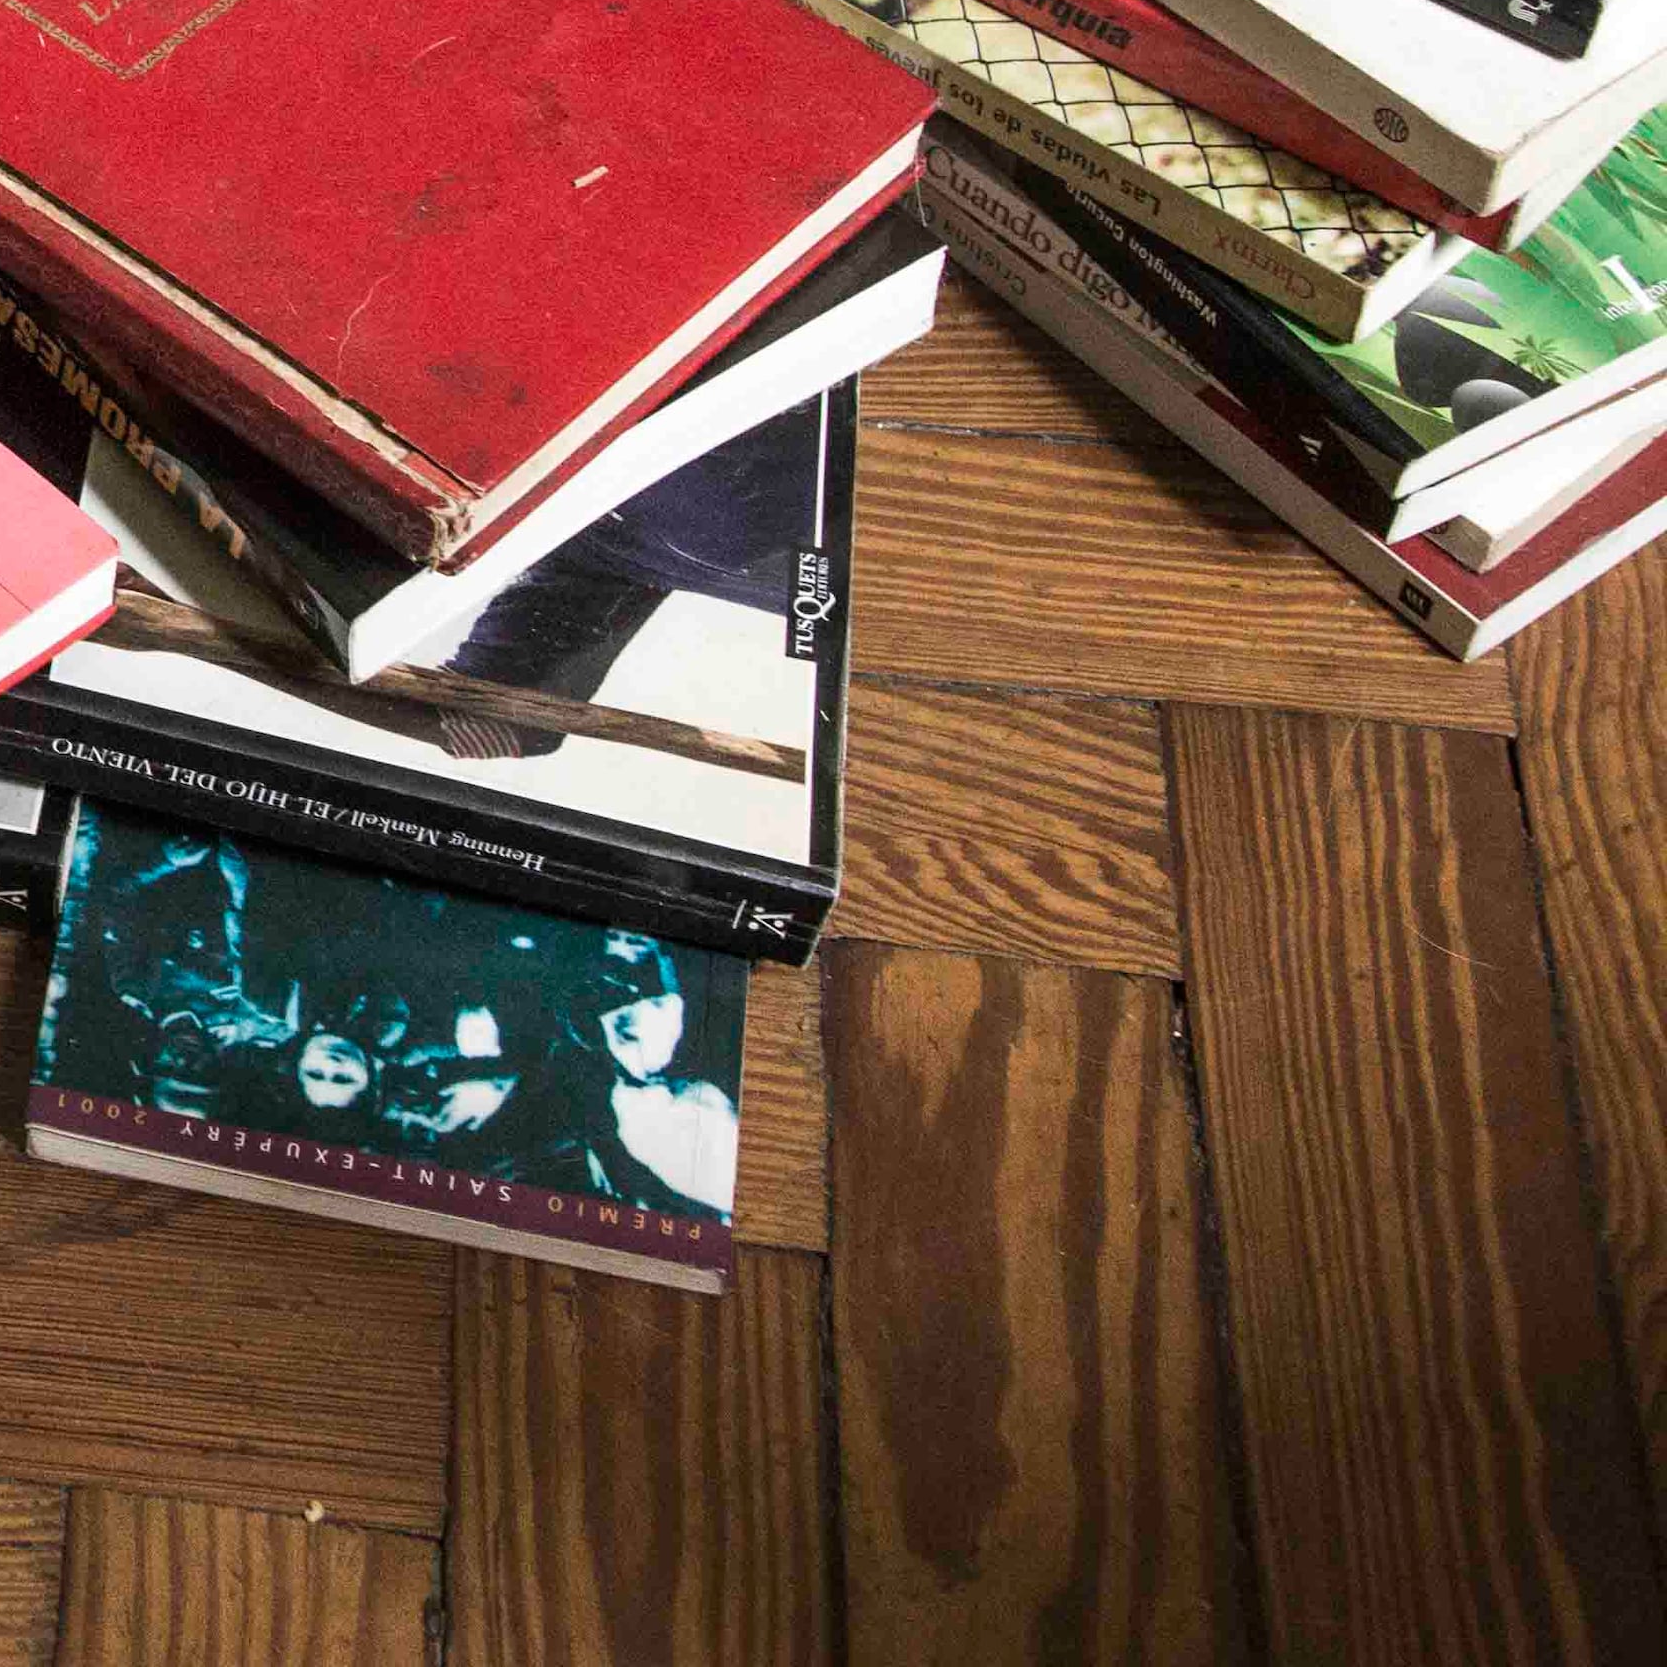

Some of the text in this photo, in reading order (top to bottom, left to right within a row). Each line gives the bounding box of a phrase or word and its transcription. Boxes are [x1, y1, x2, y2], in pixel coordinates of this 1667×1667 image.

[948, 81, 986, 110] los
[993, 106, 1030, 135] de
[1030, 129, 1110, 181] viudas
[925, 144, 1131, 311] Cuando digo
[1120, 178, 1163, 217] Las
[1127, 235, 1219, 329] Washington
[197, 492, 249, 560] LA
[793, 551, 835, 656] TUSQUETS
[52, 737, 546, 872] Henning Mankell EL HIJO DEL VIENTO
[54, 1091, 702, 1241] PREMIO SAINT-EXUPÉRY 2001
